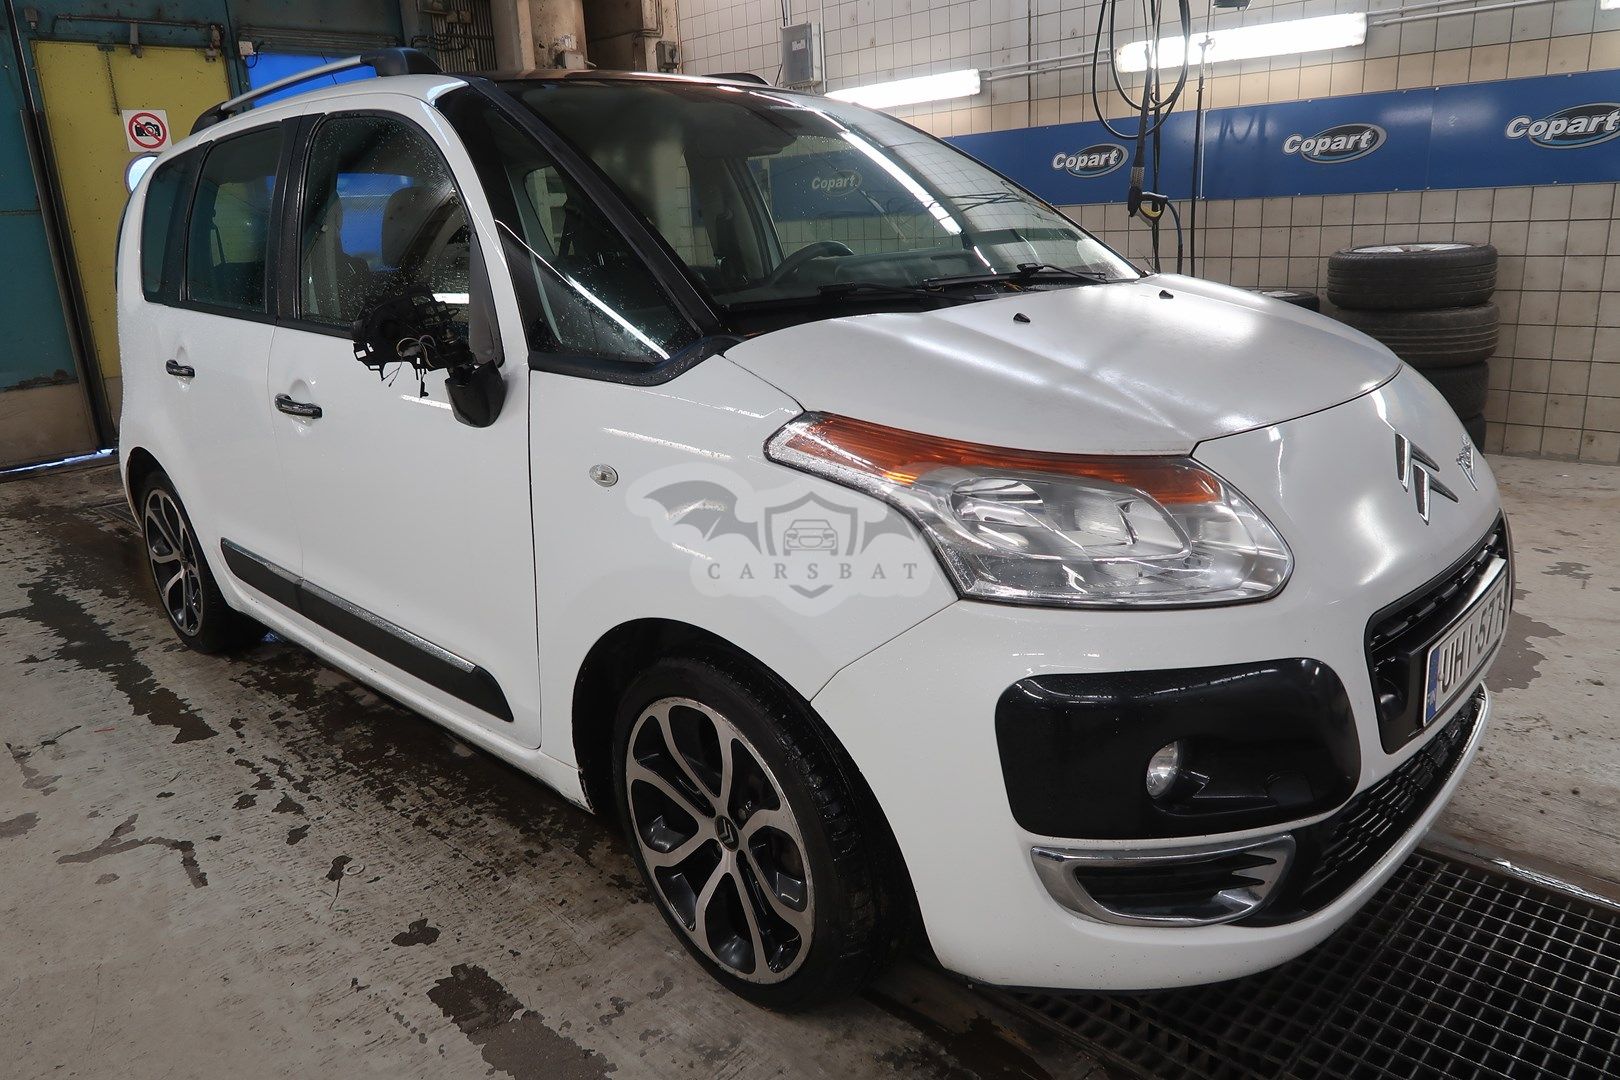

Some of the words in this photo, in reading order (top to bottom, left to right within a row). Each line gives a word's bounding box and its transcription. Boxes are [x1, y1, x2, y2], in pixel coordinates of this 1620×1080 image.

[1505, 110, 1620, 140] Copart
[1282, 129, 1372, 157] Copart
[1052, 148, 1120, 171] Copart
[811, 174, 856, 192] Copart
